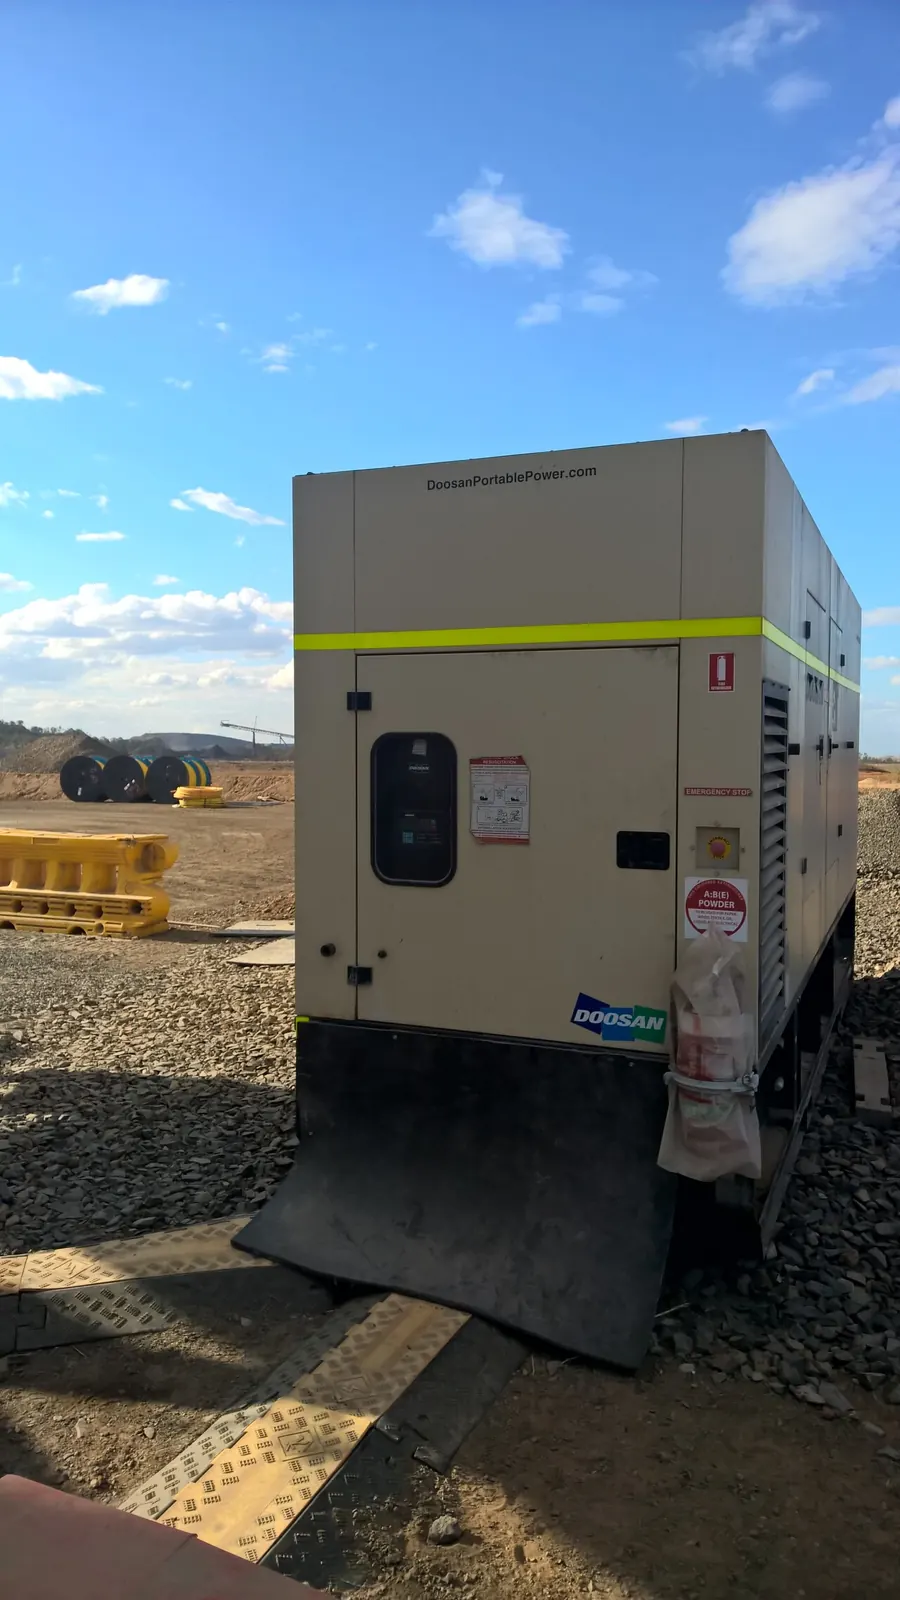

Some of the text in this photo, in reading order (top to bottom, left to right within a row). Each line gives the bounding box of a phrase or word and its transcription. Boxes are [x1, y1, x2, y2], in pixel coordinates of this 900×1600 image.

[427, 465, 597, 491] DoosanPortablePower.com
[686, 788, 731, 796] EMERGENCY
[703, 890, 730, 900] A:B(E)
[698, 899, 735, 909] POWDER
[574, 1009, 664, 1030] DOOSAN
